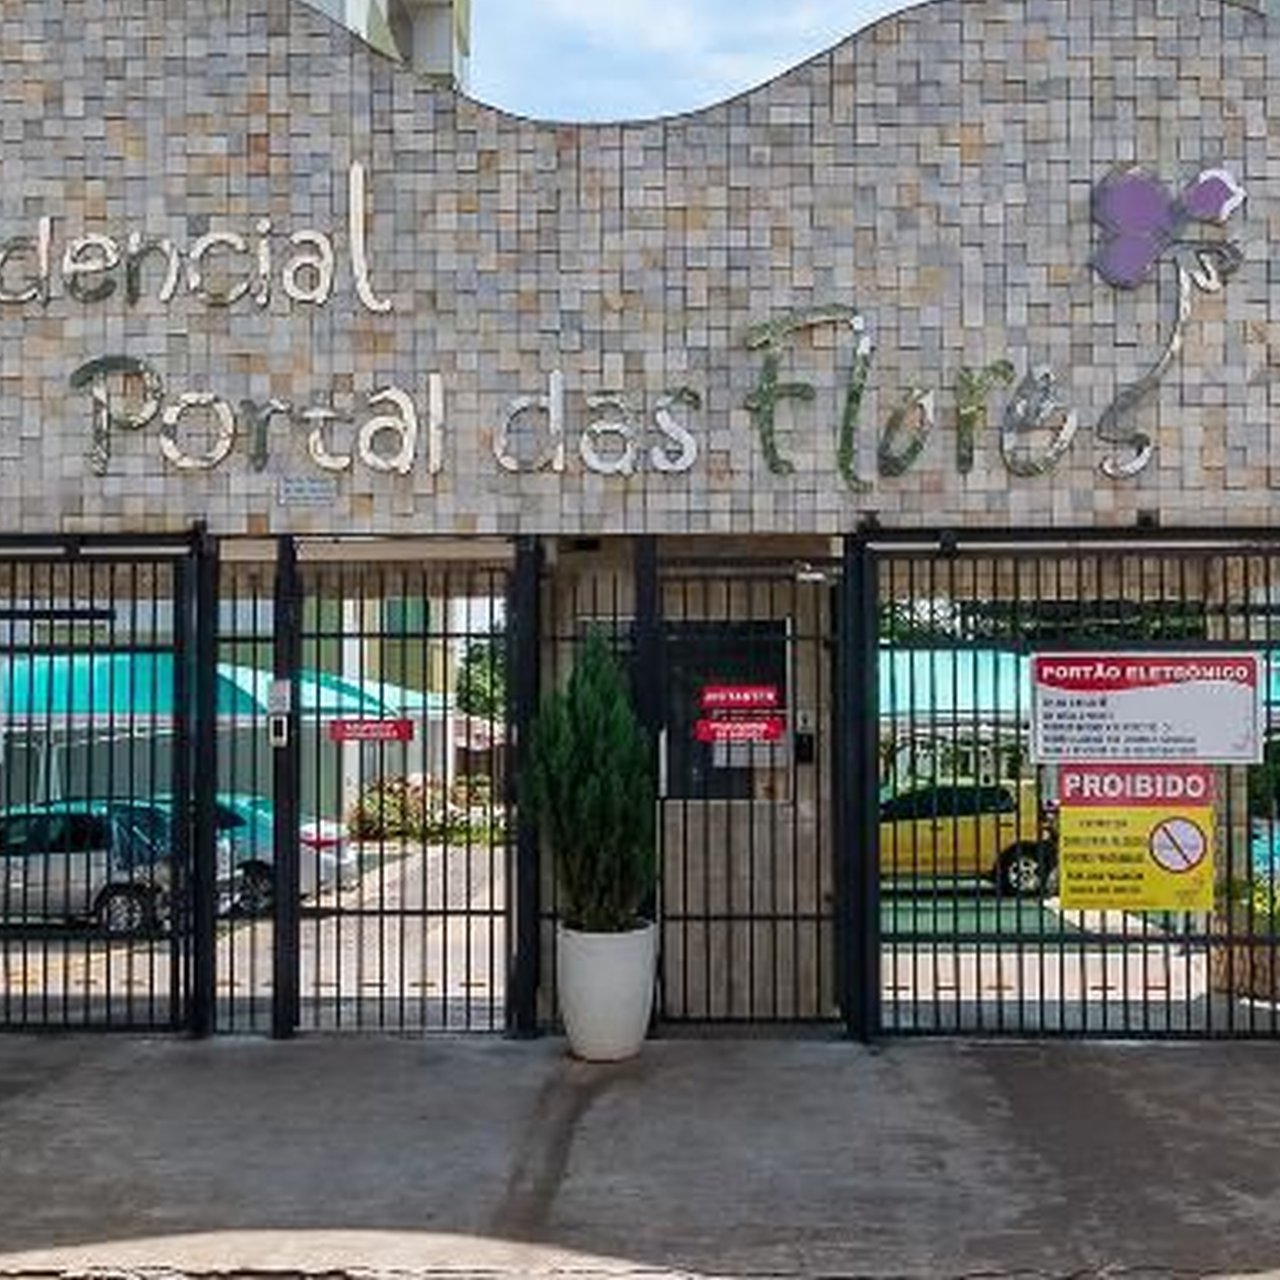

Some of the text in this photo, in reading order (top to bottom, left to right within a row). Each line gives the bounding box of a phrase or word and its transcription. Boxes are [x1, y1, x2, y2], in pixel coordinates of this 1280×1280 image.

[69, 303, 1162, 492] Portal das Flores
[1042, 662, 1120, 680] PORTÃO
[1064, 773, 1206, 799] PROIBIDO
